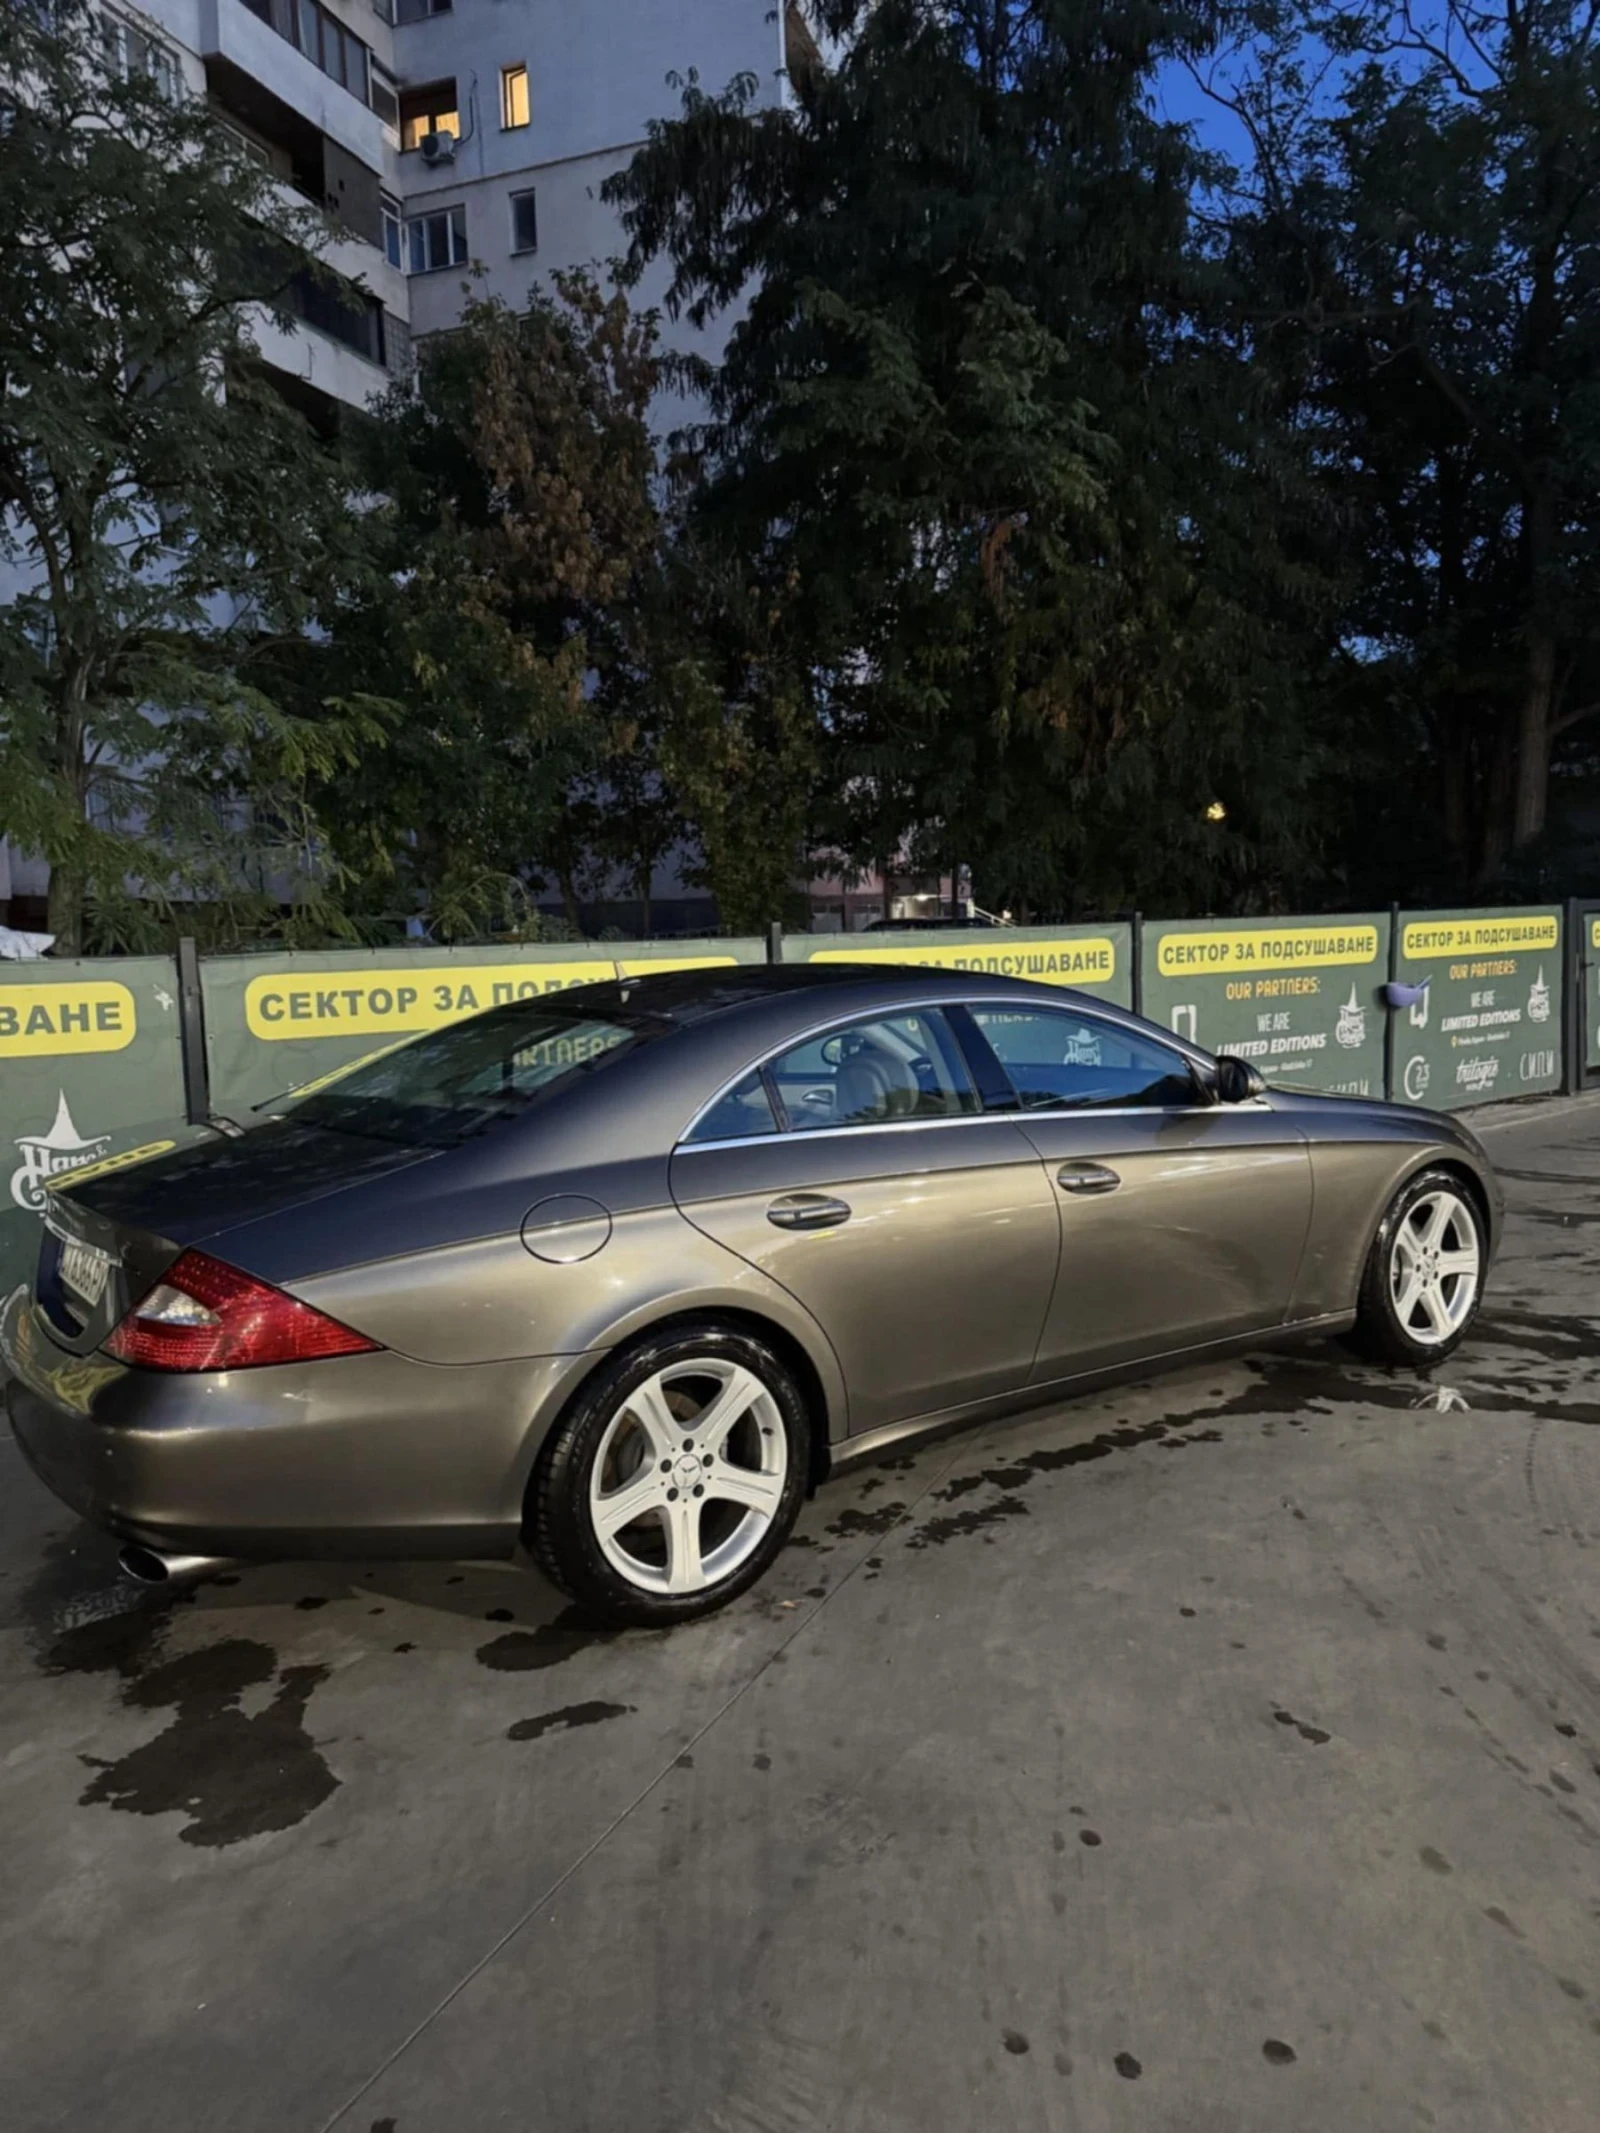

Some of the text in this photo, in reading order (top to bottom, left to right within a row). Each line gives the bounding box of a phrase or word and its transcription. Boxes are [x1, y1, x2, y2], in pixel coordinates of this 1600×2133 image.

[1407, 925, 1555, 949] СЕКТОР ЗА ПОДСУШАВАНЕ
[1163, 936, 1375, 964] СЕКТОР ЗА ПОДСУШАВАНЕ
[1449, 964, 1469, 980] OUR
[1226, 976, 1321, 1000] OUR PARTNERS:
[259, 986, 418, 1022] СЕКТОР
[433, 984, 480, 1012] ЗА
[1257, 1012, 1291, 1032] WE ARE
[1441, 1008, 1521, 1032] LIMITED EDITIONS
[1270, 1033, 1328, 1054] EDITIONS
